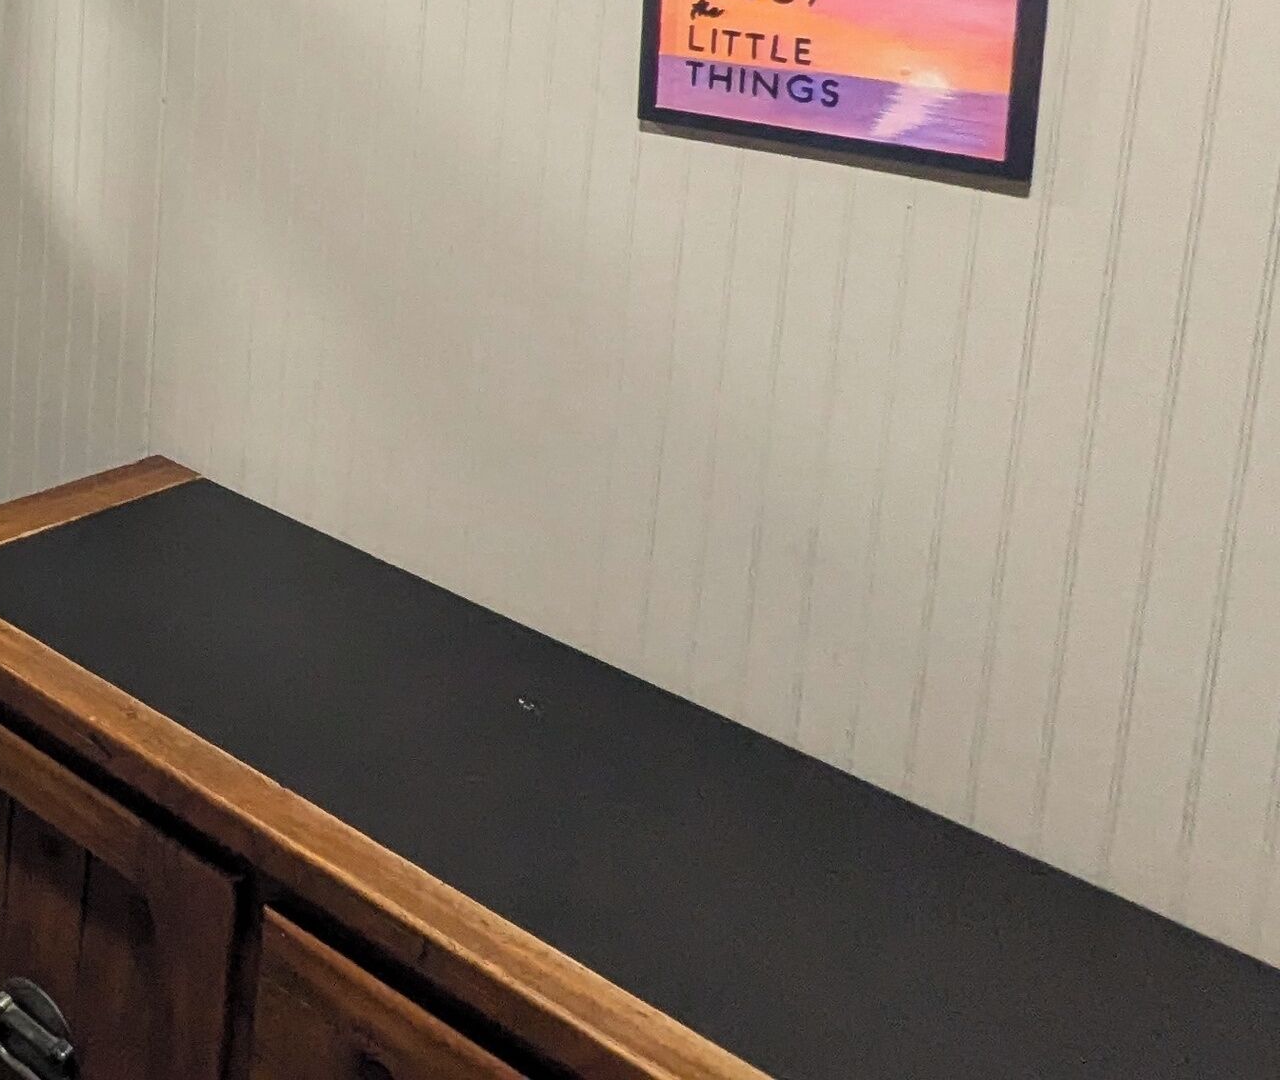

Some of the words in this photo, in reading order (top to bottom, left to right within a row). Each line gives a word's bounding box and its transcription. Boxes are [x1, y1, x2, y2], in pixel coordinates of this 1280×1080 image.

[690, 0, 725, 20] the
[688, 24, 811, 66] LITTLE
[686, 60, 839, 107] THINGS
